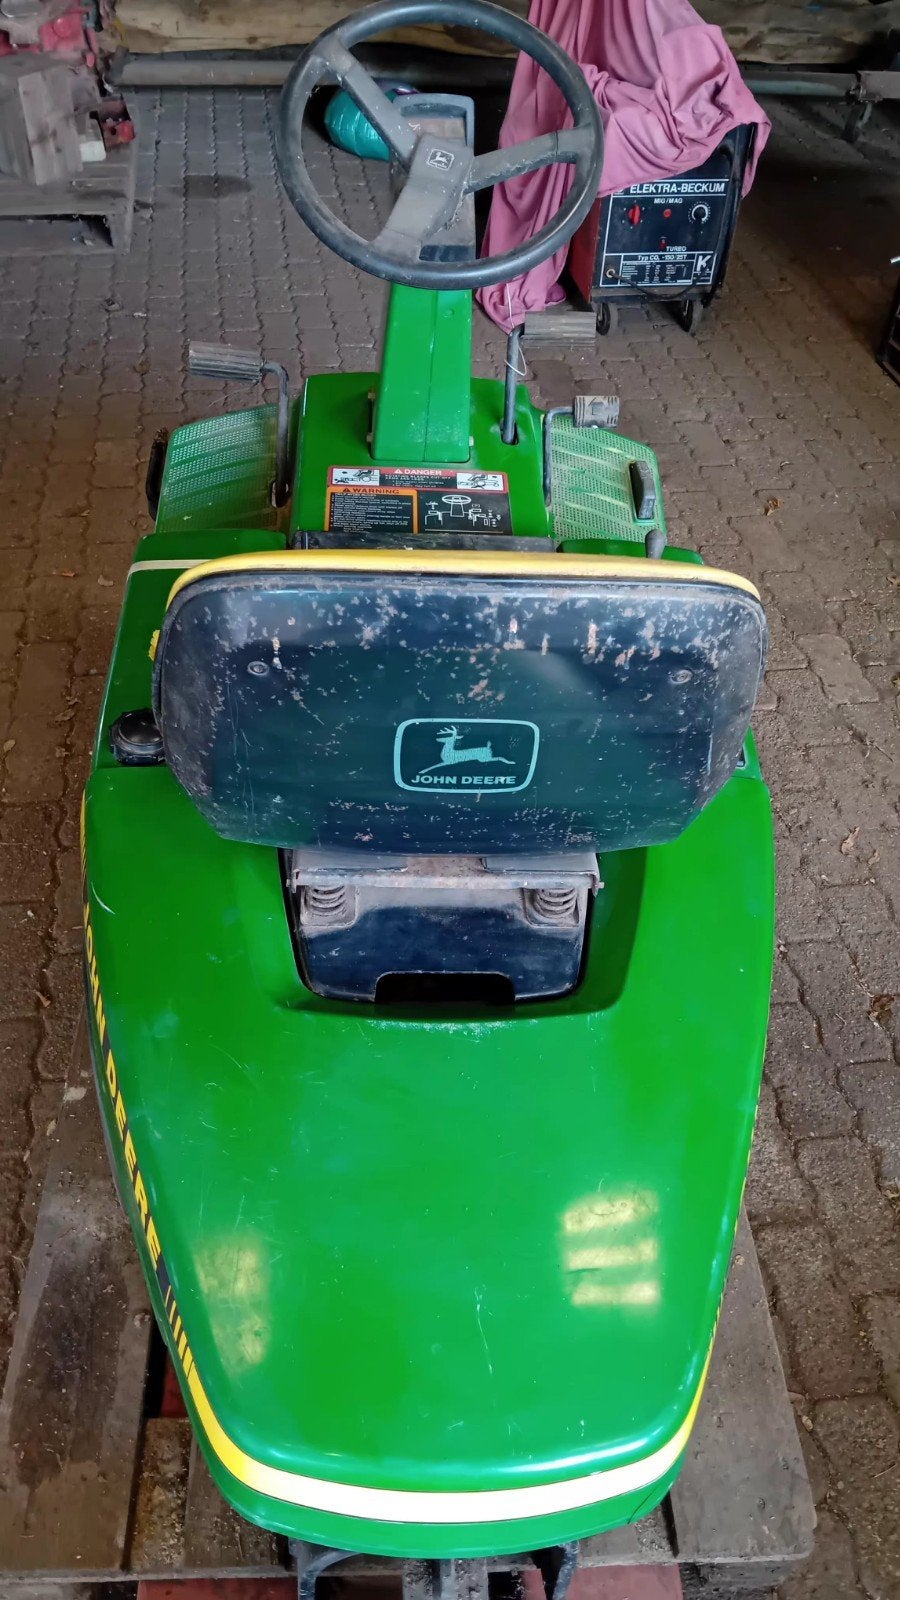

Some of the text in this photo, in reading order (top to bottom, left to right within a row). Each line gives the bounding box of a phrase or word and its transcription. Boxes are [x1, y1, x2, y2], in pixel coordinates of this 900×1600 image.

[630, 183, 725, 194] ELEKTRA-BECKUM
[411, 775, 516, 785] JOHN DEERE
[106, 1048, 161, 1272] DEERE
